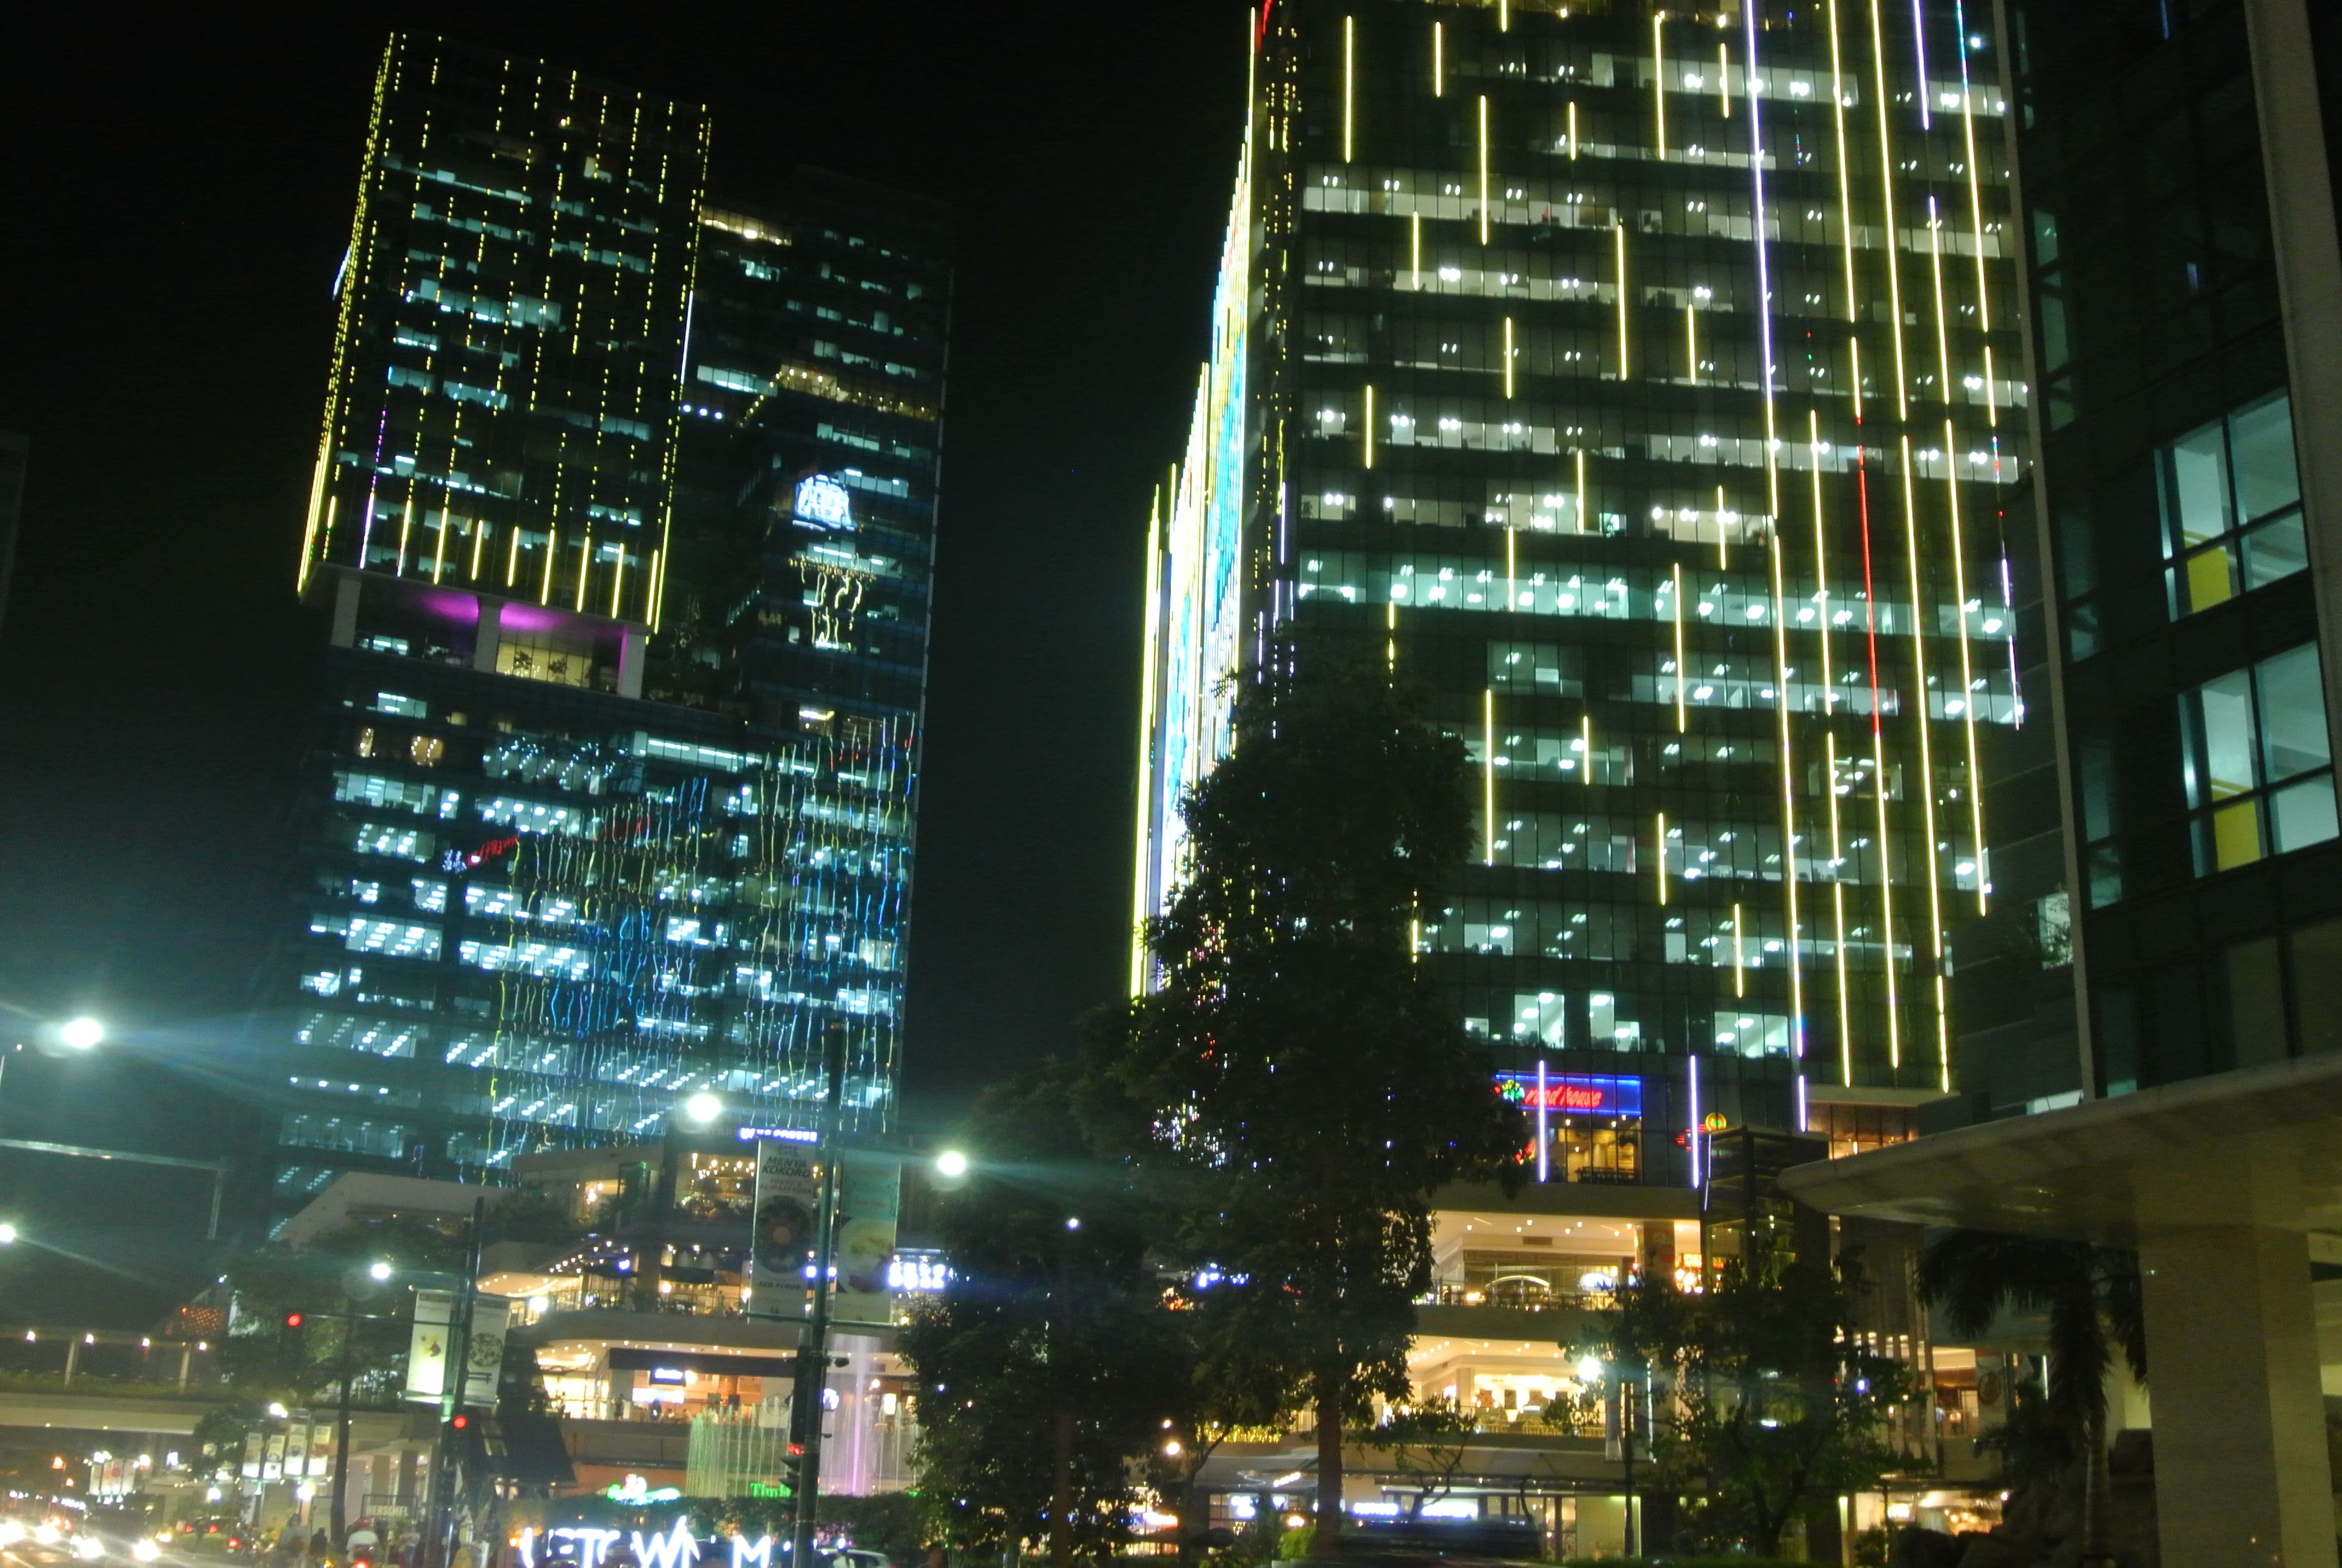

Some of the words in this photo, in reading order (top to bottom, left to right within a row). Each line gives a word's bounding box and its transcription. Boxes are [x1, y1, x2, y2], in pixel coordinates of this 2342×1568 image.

[1560, 1086, 1603, 1108] house
[766, 1156, 806, 1168] MENYA
[762, 1164, 811, 1178] KOKORO
